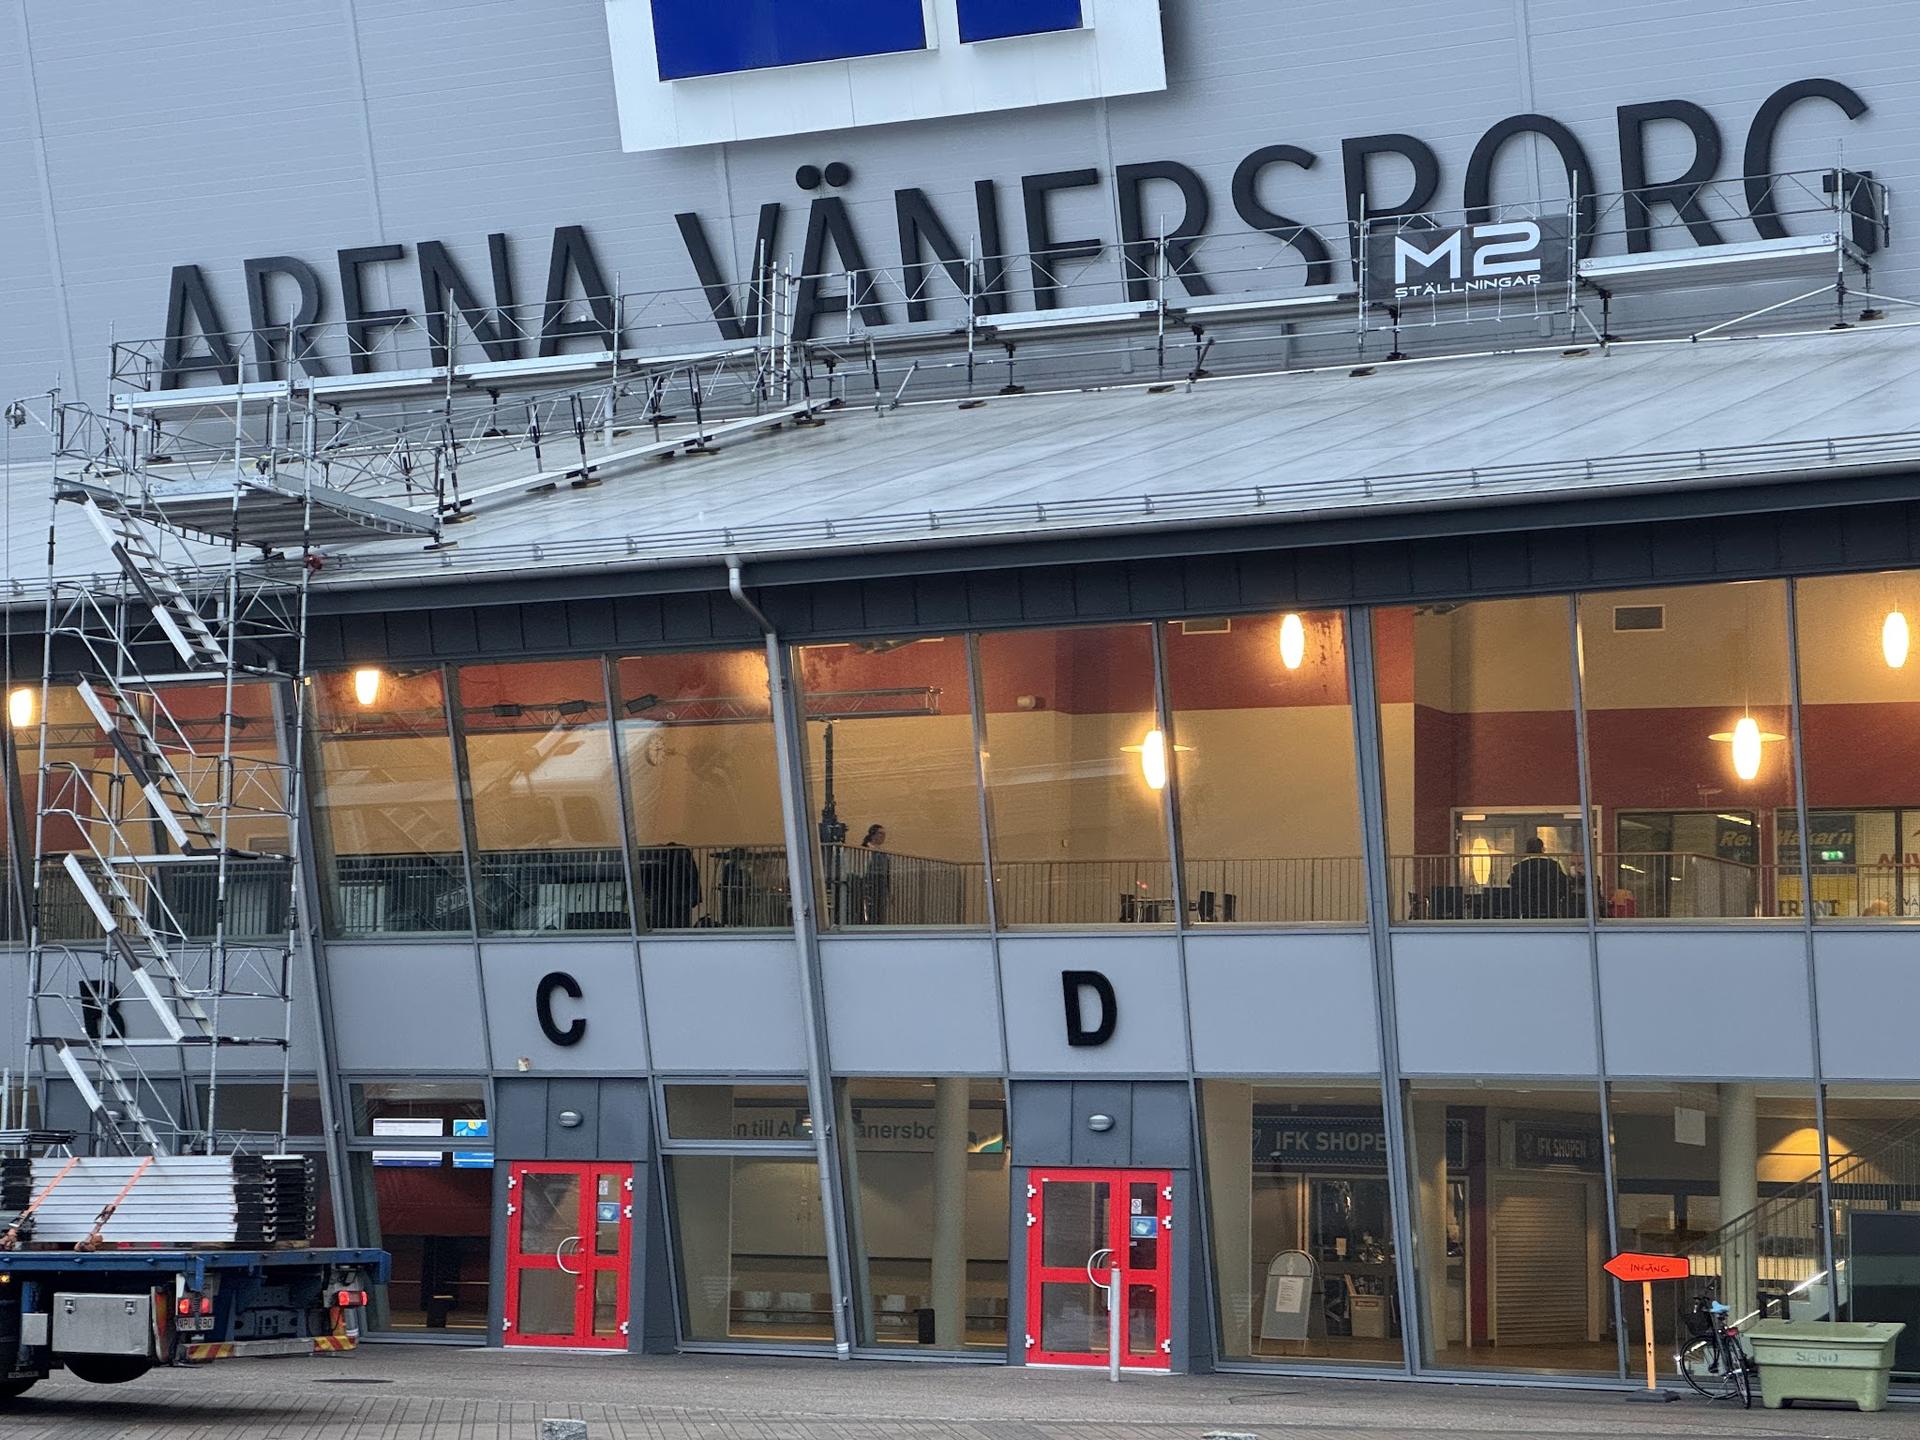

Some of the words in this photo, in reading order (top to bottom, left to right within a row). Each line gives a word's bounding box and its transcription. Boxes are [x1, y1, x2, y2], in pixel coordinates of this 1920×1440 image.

[161, 225, 620, 391] ARENA
[674, 77, 1879, 342] VÄNERSBORG
[1395, 221, 1541, 284] M2
[1395, 274, 1541, 298] STÄLLNINGAR
[79, 980, 126, 1039] B
[536, 971, 587, 1047] C
[1062, 970, 1118, 1046] D
[752, 1119, 773, 1137] till
[1275, 1131, 1310, 1150] IFK
[1316, 1131, 1388, 1151] SHOPE
[1630, 1263, 1669, 1273] INGÅNG
